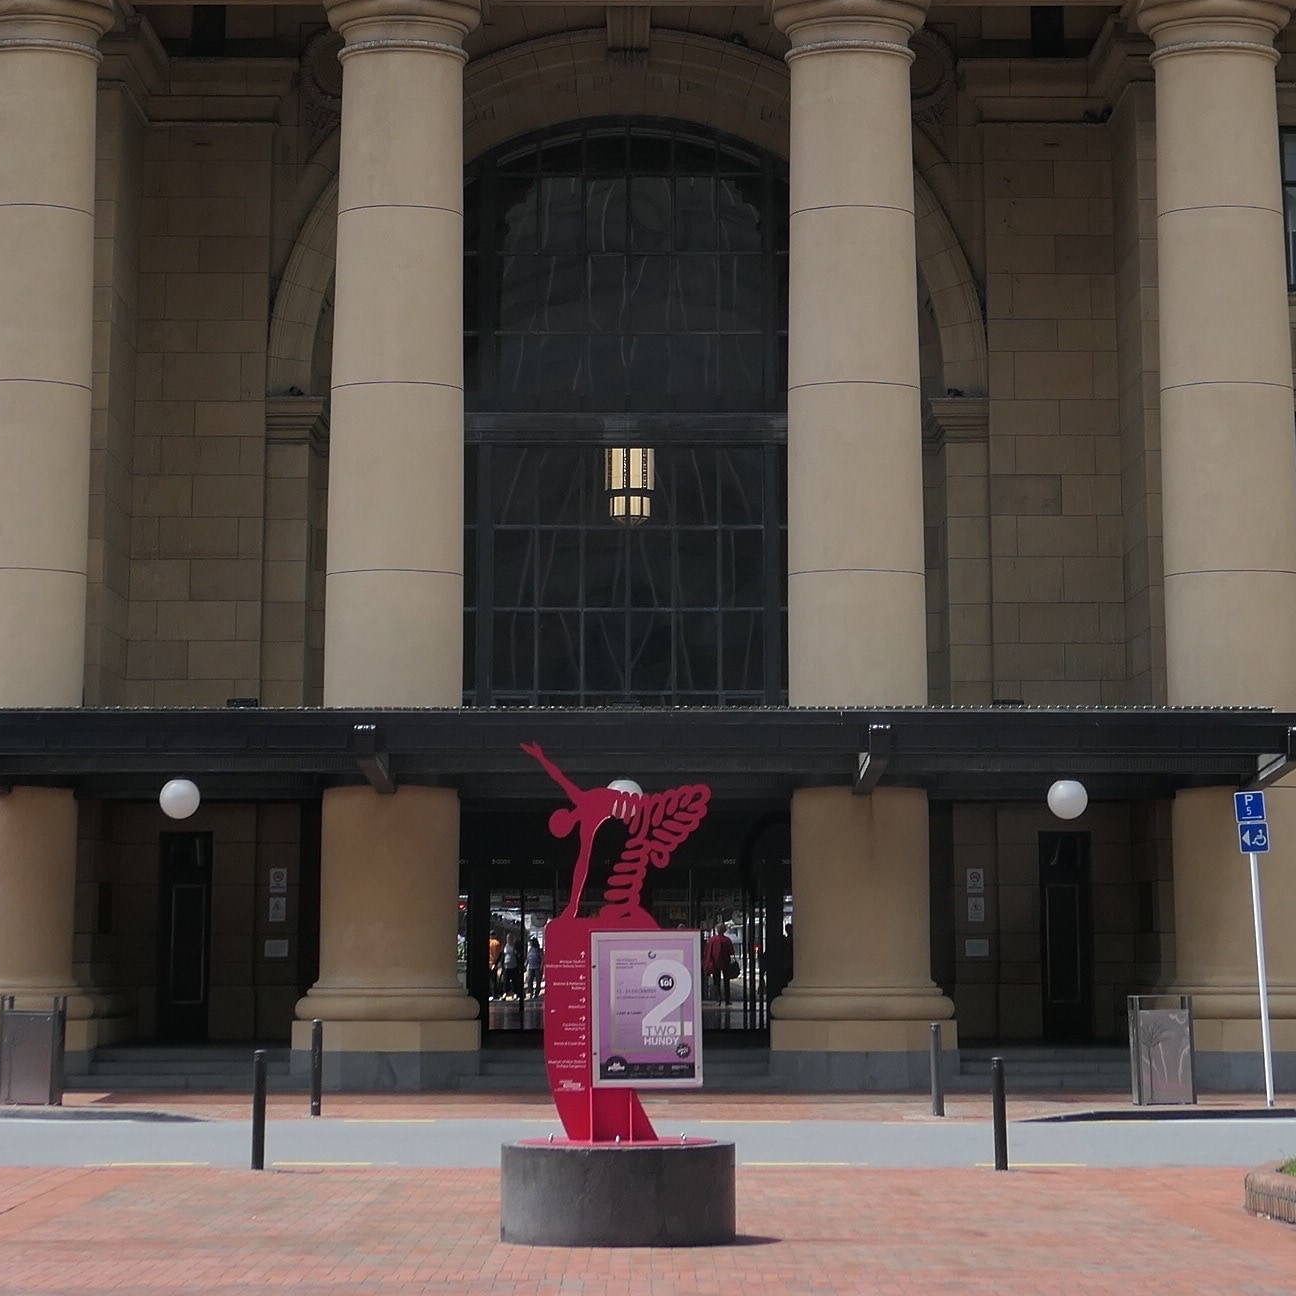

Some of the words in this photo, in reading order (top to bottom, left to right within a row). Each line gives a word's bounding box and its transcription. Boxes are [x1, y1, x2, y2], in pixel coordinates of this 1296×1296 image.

[1244, 794, 1254, 806] P
[1246, 806, 1252, 816] 5
[641, 959, 693, 1036] 2
[645, 1025, 677, 1036] TWO
[643, 1036, 679, 1046] HUNDY
